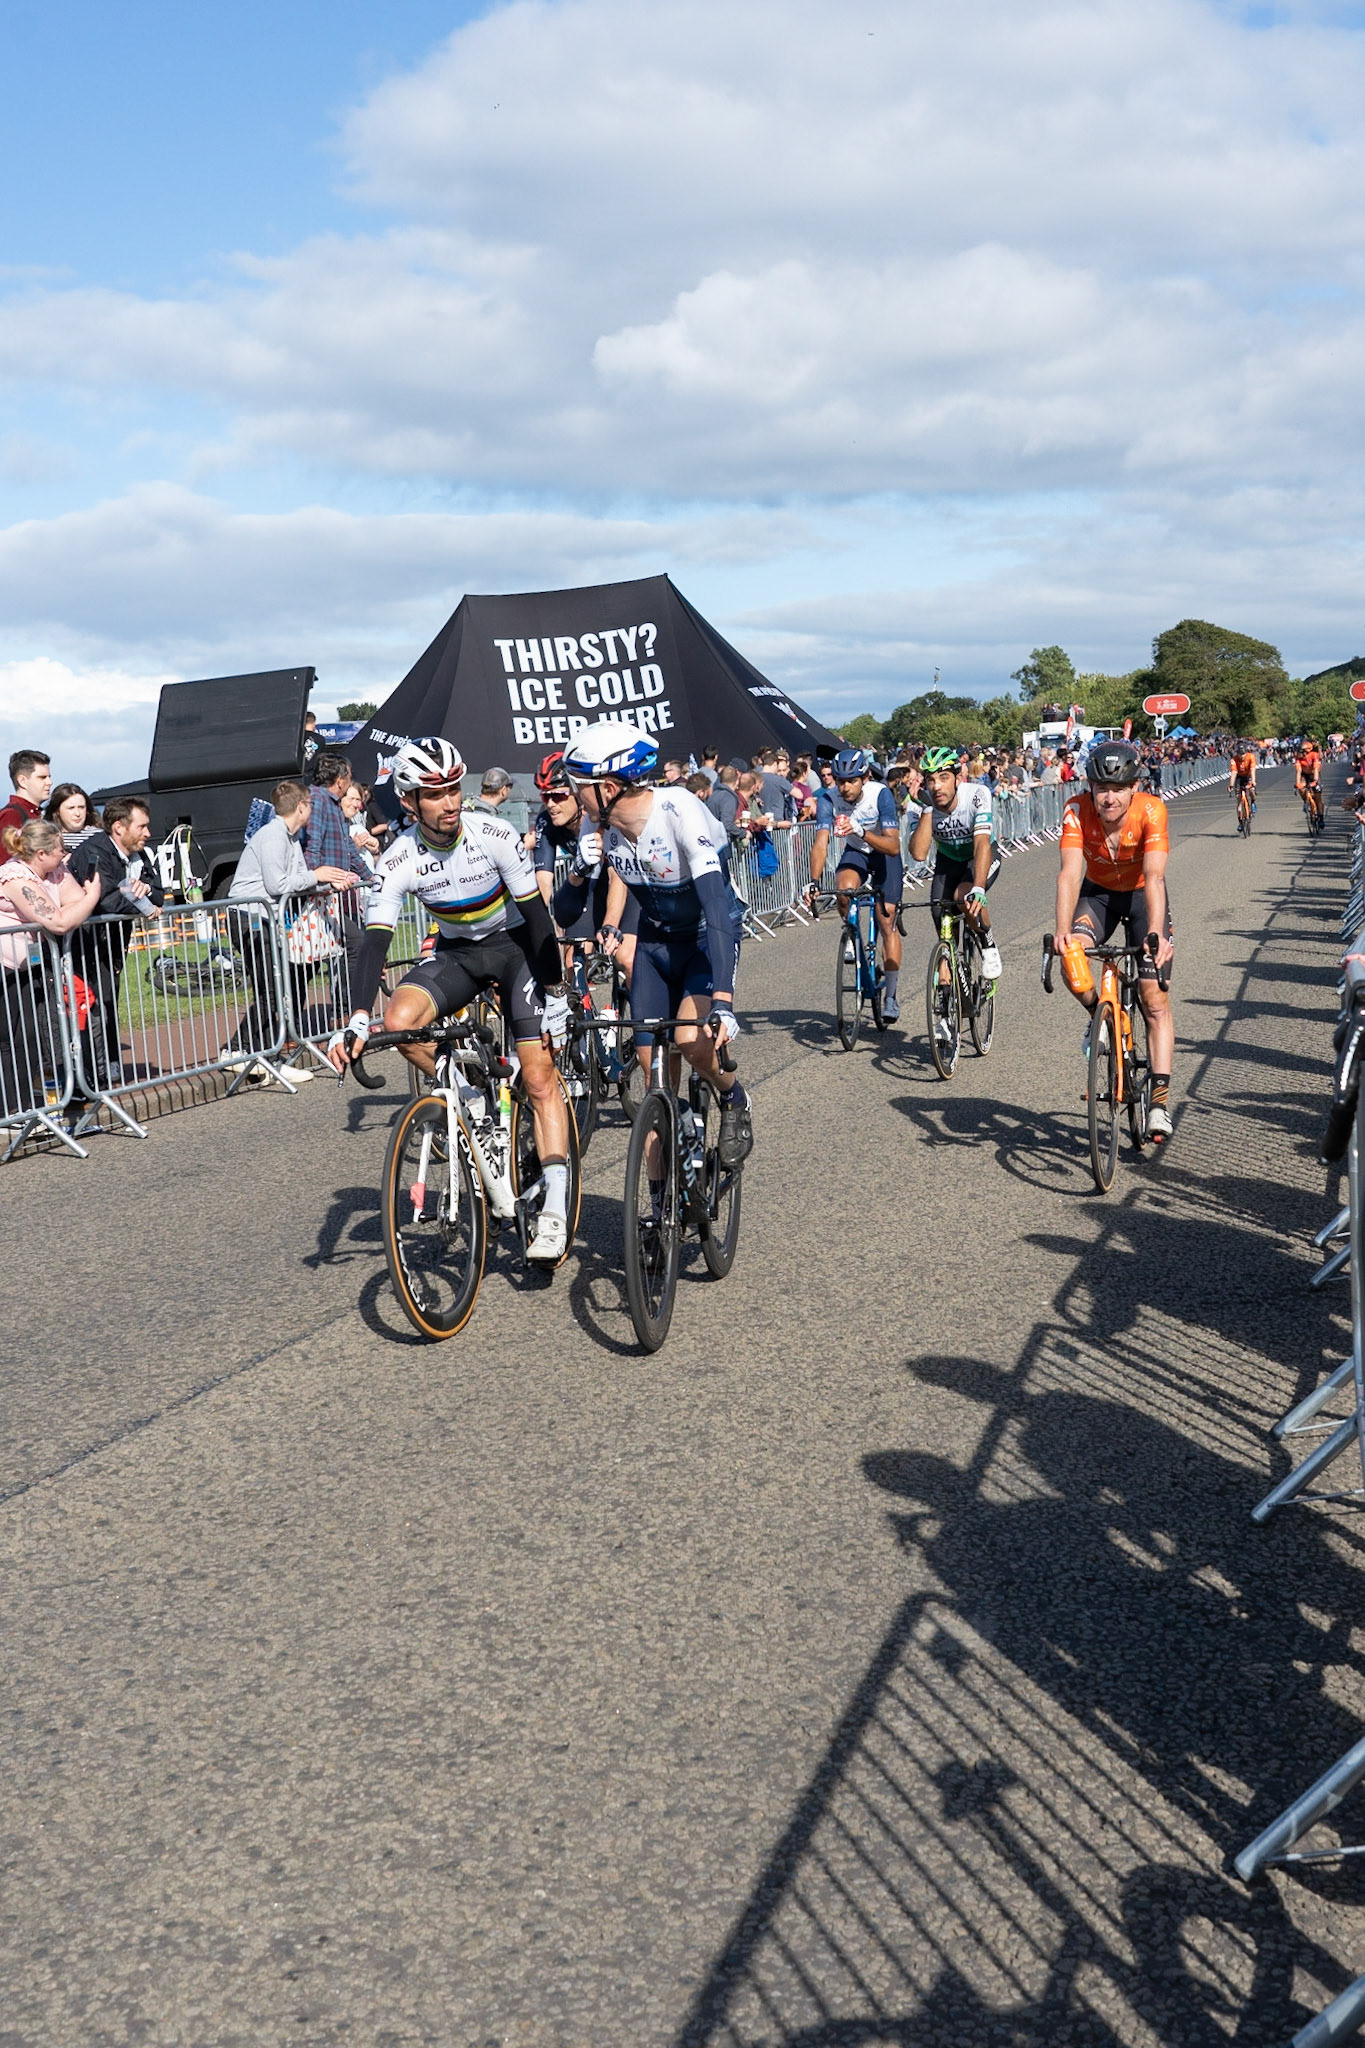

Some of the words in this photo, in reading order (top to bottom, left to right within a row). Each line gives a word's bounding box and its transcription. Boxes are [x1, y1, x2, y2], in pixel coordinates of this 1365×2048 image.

[493, 622, 658, 673] THIRSTY?
[506, 677, 567, 711] ICE
[574, 663, 666, 708] COLD
[369, 728, 388, 744] THE
[512, 715, 589, 744] BEER
[482, 822, 511, 841] crivit
[419, 860, 445, 876] UCI
